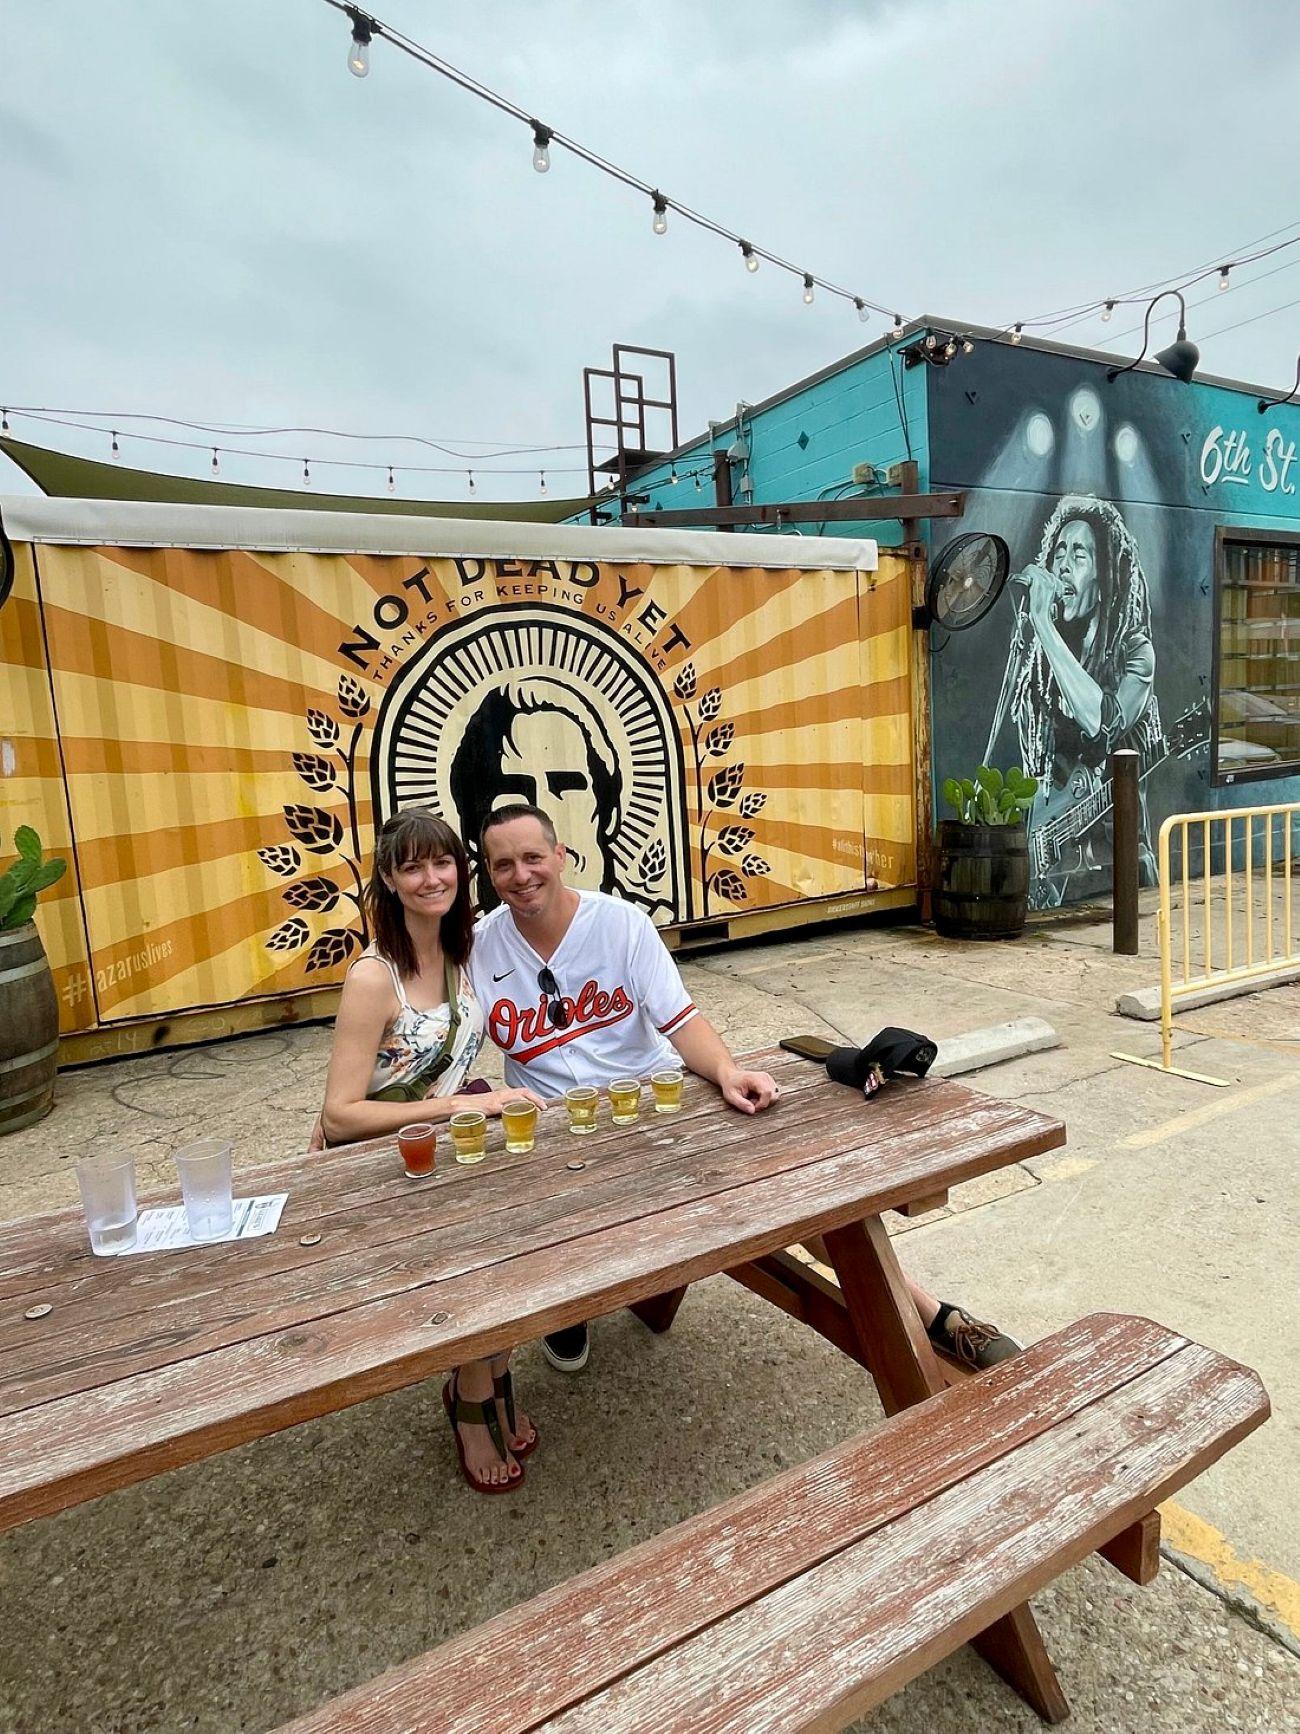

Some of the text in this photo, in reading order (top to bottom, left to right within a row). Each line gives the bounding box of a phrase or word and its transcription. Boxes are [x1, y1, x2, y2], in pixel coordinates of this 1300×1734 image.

[1200, 425, 1252, 485] 6th
[338, 559, 692, 671] NOT DEAD YET
[373, 584, 667, 681] THANKS FOR KEEPING US ALIVE
[62, 939, 173, 1008] #azaruslives
